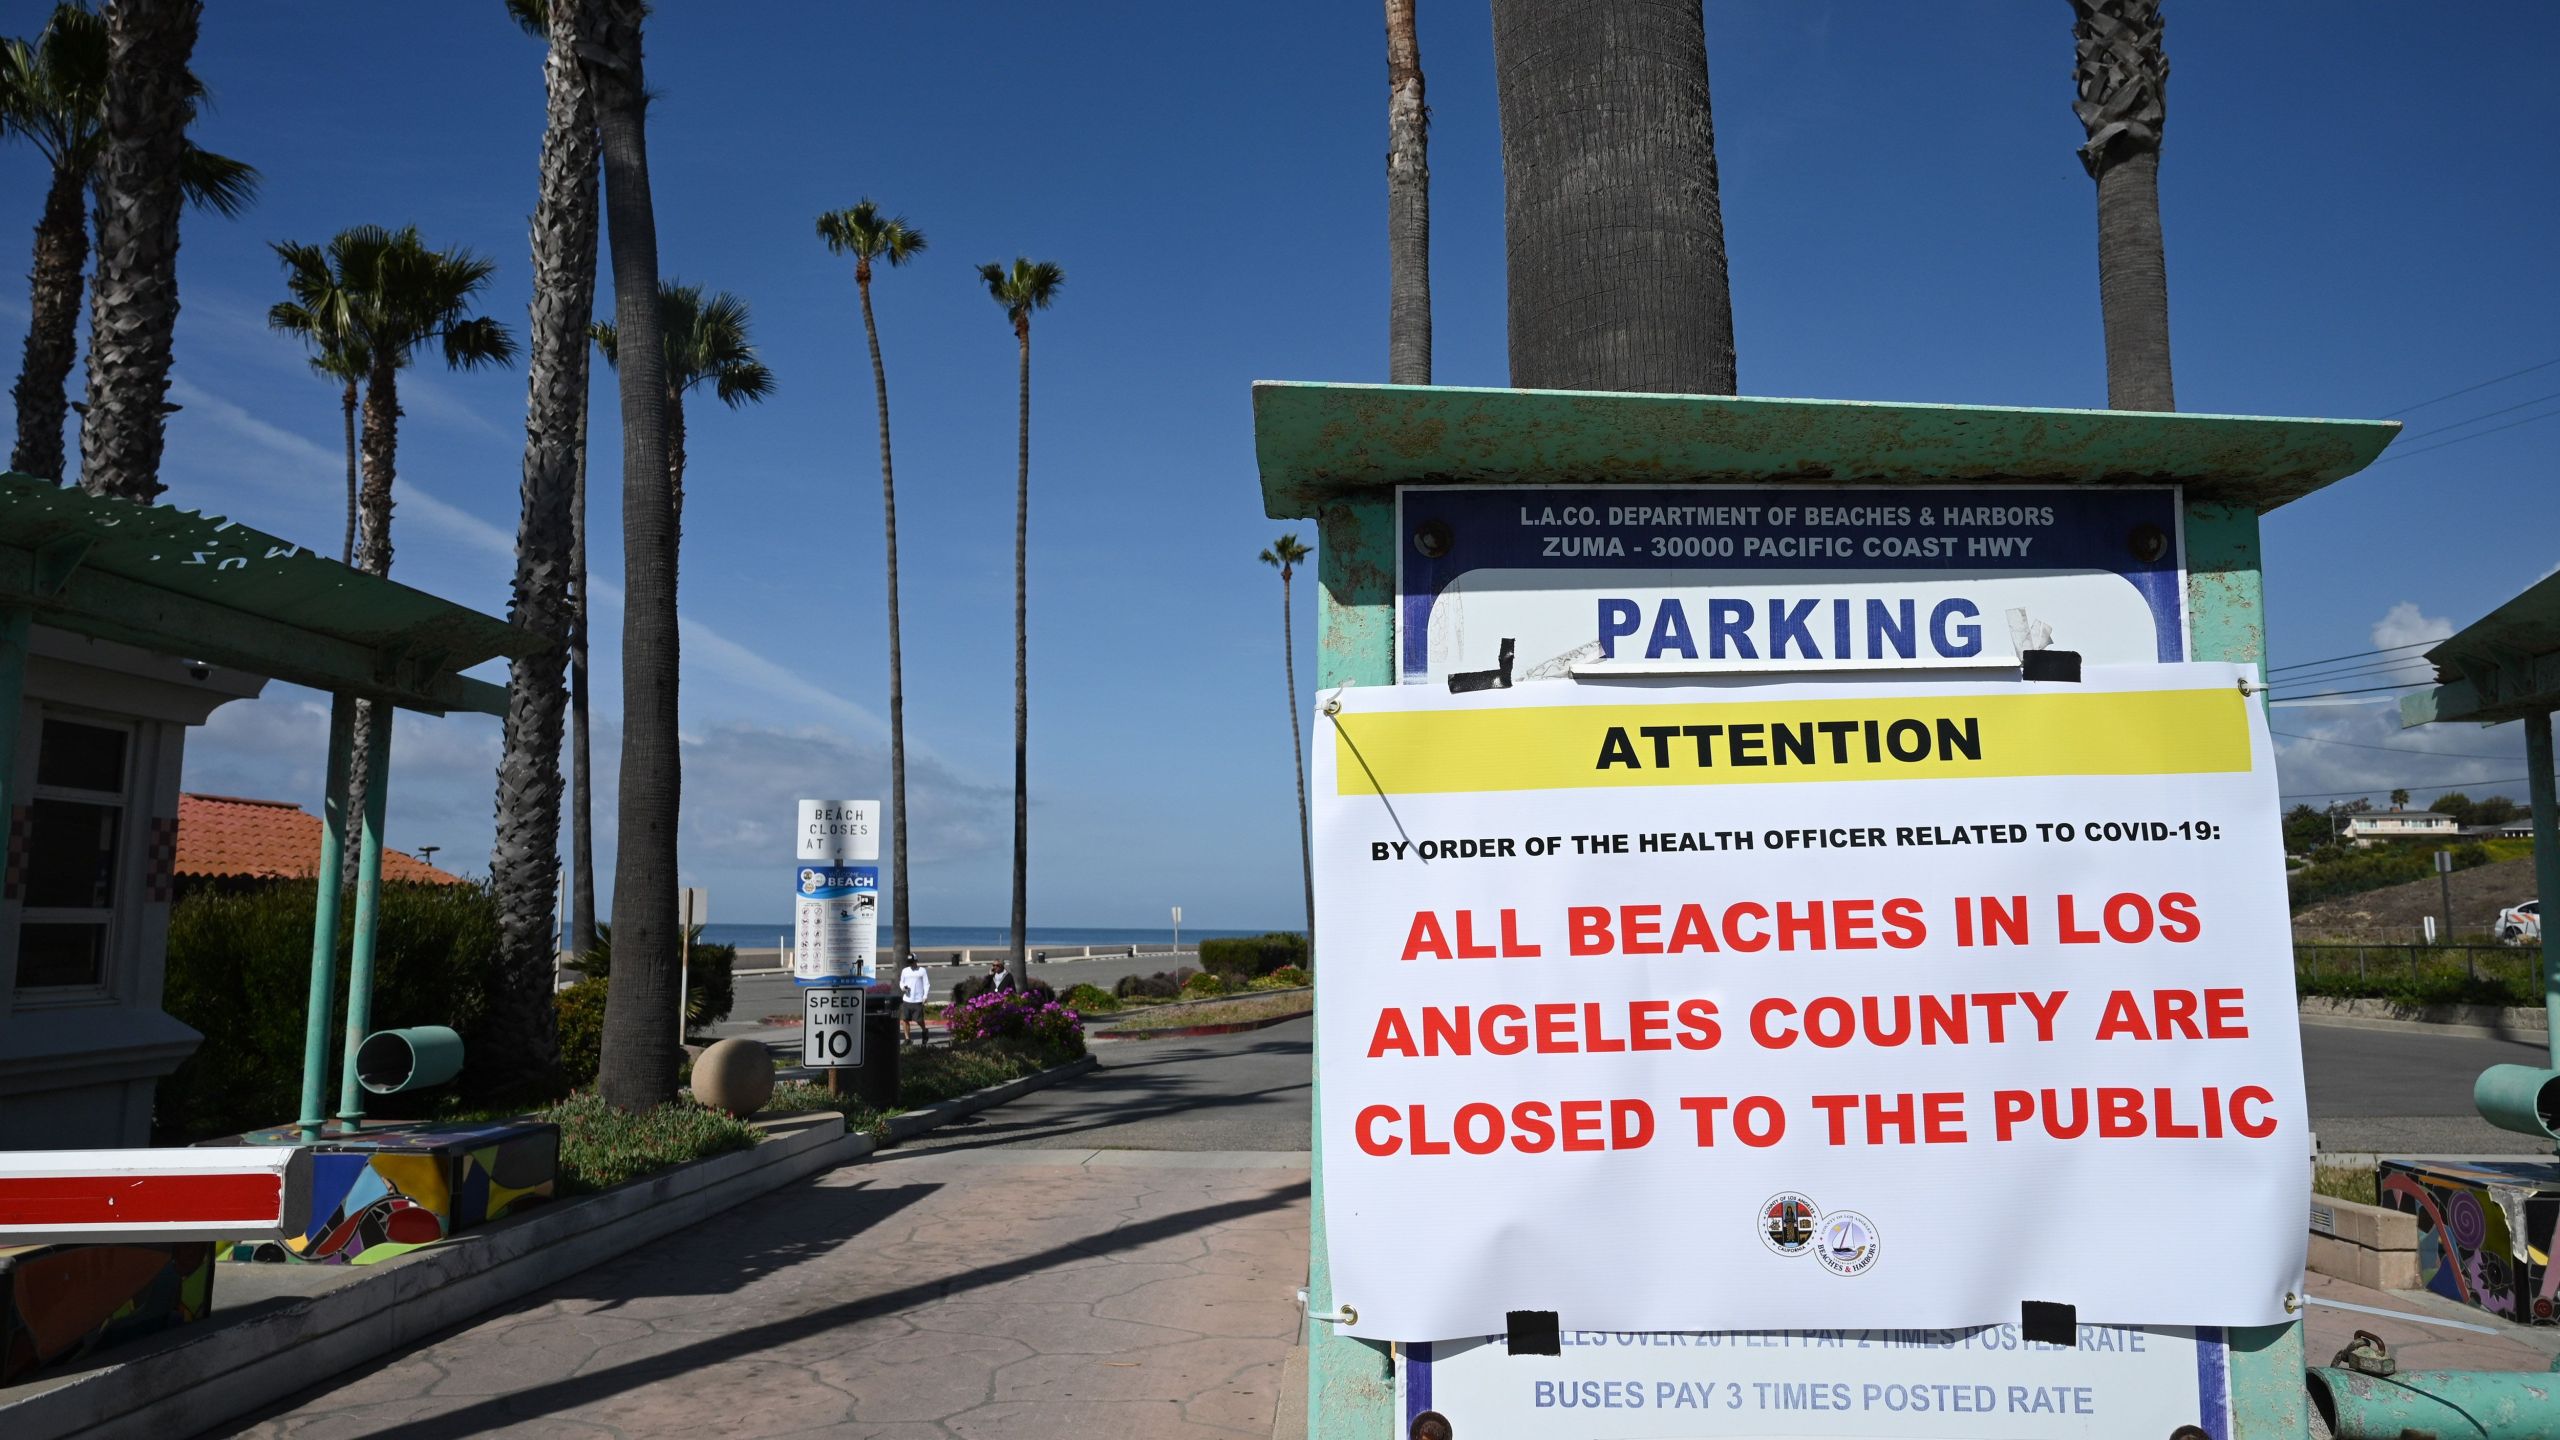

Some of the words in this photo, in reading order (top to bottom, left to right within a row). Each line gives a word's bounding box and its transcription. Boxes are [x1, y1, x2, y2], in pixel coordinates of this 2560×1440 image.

[1521, 507, 1600, 525] L.A.CO.
[1609, 507, 1761, 525] DEPARTMENT
[1768, 507, 1796, 525] OF
[1805, 507, 1911, 526] BEACHES
[1920, 507, 1935, 525] &
[1944, 507, 2054, 525] HARBORS
[1543, 537, 1625, 556] ZUMA
[1652, 537, 1733, 556] 30000
[1744, 537, 1853, 557] PACIFIC
[1863, 537, 1957, 557] COAST
[1968, 538, 2032, 556] HWY
[1598, 598, 1982, 659] PARKING
[1596, 718, 1981, 769] ATTENTION
[815, 807, 864, 821] BEACH
[806, 838, 824, 850] AT
[809, 824, 868, 835] CLOSES
[1372, 843, 1408, 860] BY
[1417, 839, 1516, 860] ORDER
[1525, 837, 1561, 856] OF
[1571, 835, 1628, 854] THE
[1640, 831, 1753, 852] HEALTH
[1764, 828, 1887, 849] OFFICER
[1896, 825, 2027, 846] RELATED
[2036, 823, 2074, 842] TO
[2085, 821, 2220, 841] COVID-19:
[827, 877, 873, 887] BEACH
[1401, 909, 1541, 960] ALL
[1568, 898, 1926, 956] BEACHES
[1955, 896, 2028, 946] IN
[2058, 892, 2200, 944] LOS
[809, 997, 860, 1008] SPEED
[814, 1013, 854, 1025] LIMIT
[1367, 999, 1721, 1057] ANGELES
[1750, 991, 2068, 1049] COUNTY
[2096, 989, 2248, 1040] ARE
[815, 1030, 853, 1059] 10
[1356, 1099, 1654, 1156] CLOSED
[1680, 1096, 1785, 1147] TO
[1812, 1093, 1967, 1145] THE
[1994, 1086, 2277, 1141] PUBLIC
[1765, 1199, 1779, 1215] COUNTY
[1798, 1198, 1815, 1214] ANGELES
[1818, 1244, 1843, 1272] BEACHES
[1852, 1243, 1876, 1272] HARBORS
[1803, 1329, 1845, 1348] PAY
[1878, 1329, 1956, 1350] TIMES
[1965, 1322, 2067, 1351] POS
[2078, 1323, 2146, 1352] RATE
[1536, 1381, 1644, 1408] BUSES
[1657, 1382, 1715, 1408] PAY
[1727, 1383, 1742, 1409] 3
[1753, 1383, 1851, 1410] TIMES
[1864, 1384, 1996, 1412] POSTED
[2008, 1386, 2093, 1414] RATE
